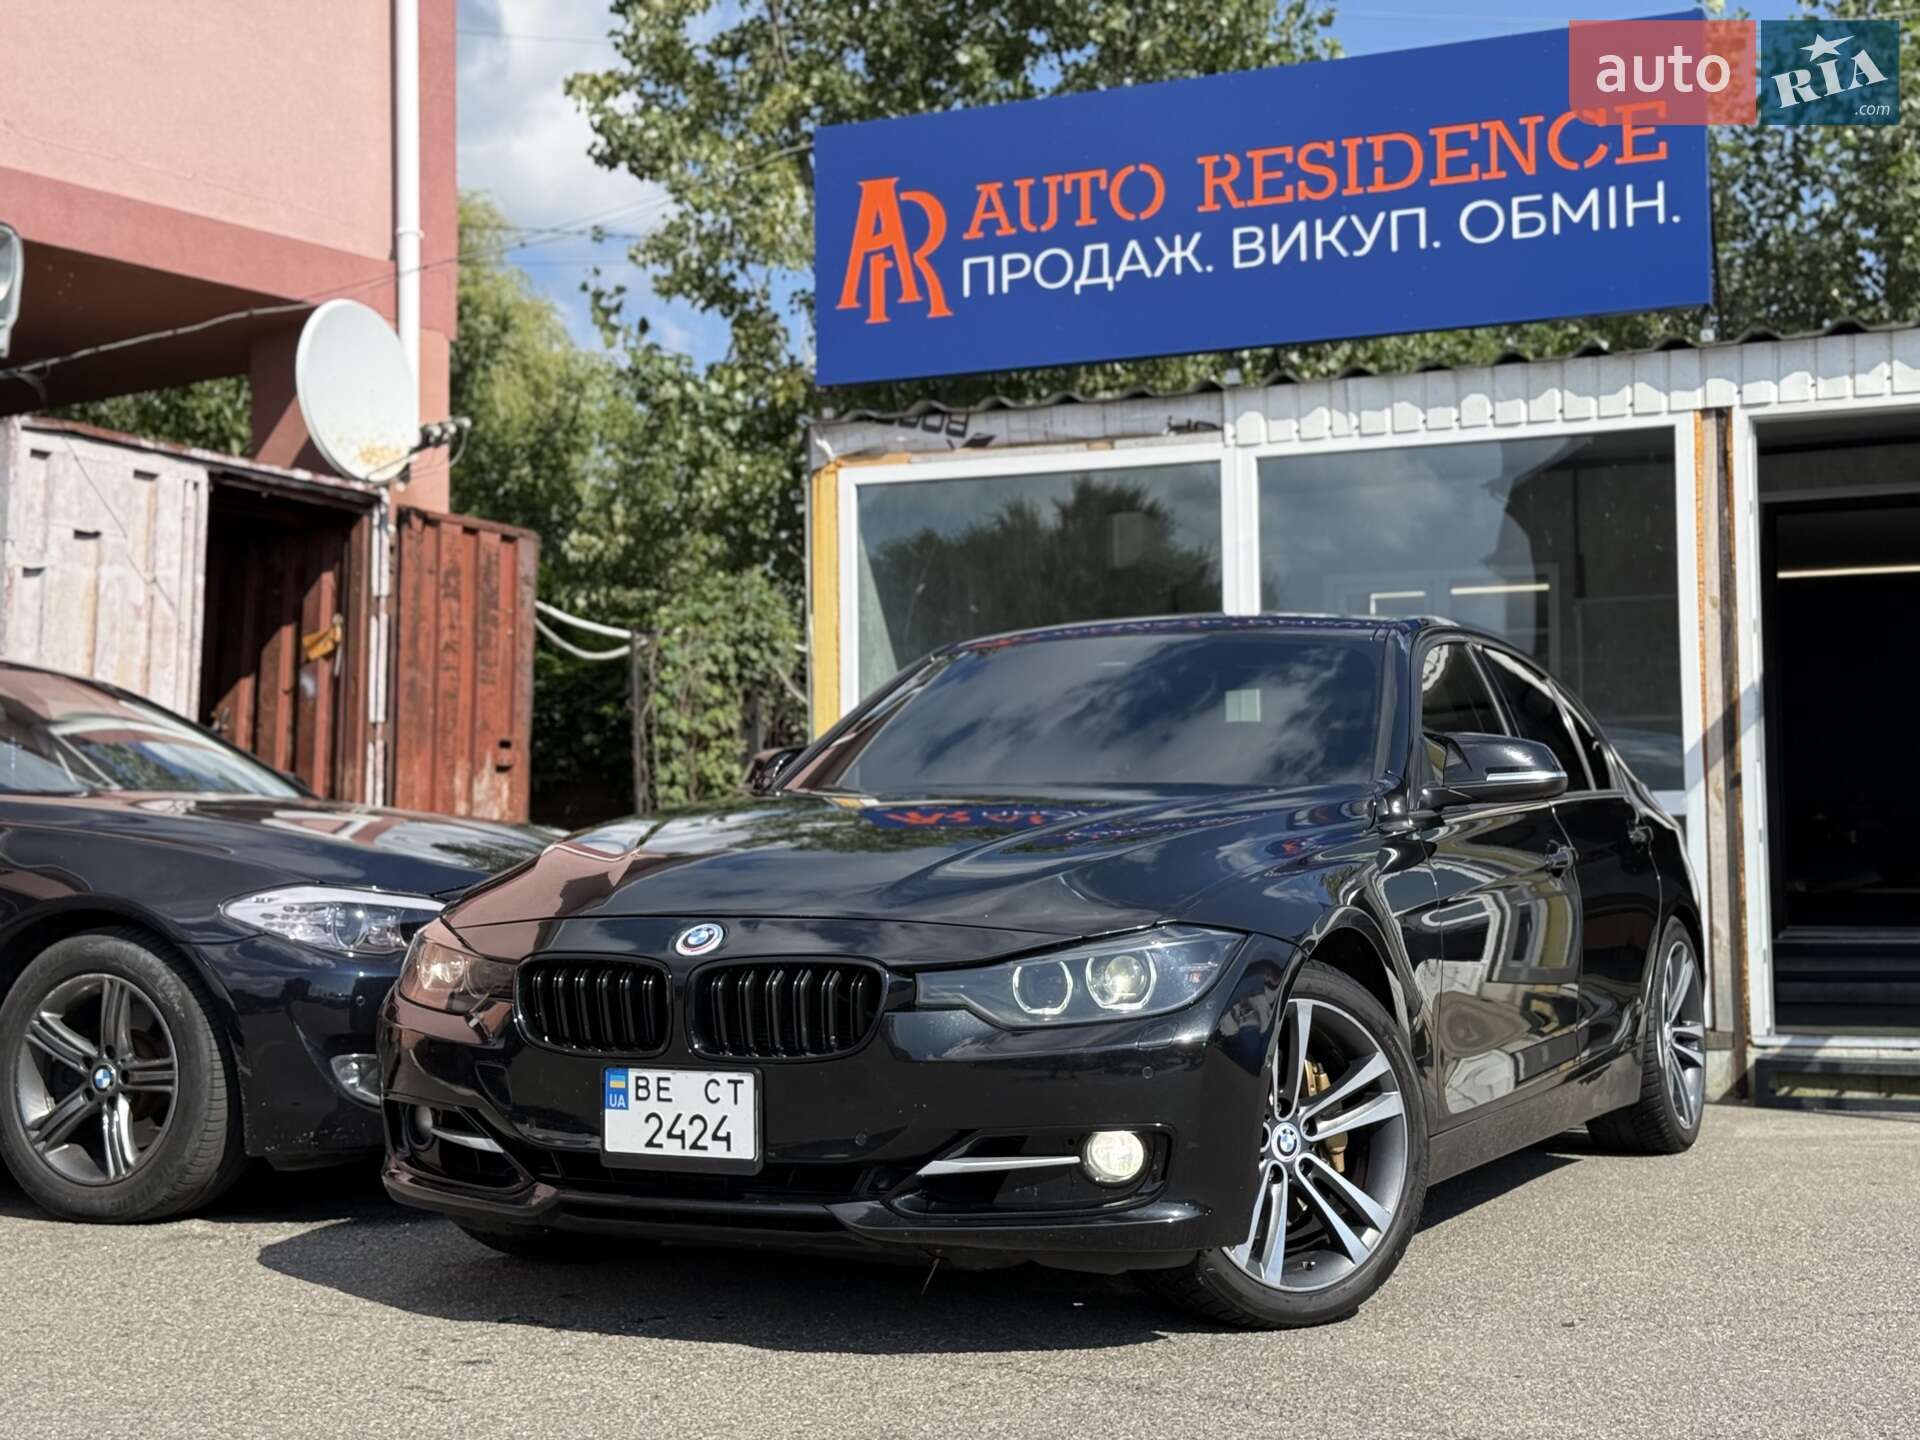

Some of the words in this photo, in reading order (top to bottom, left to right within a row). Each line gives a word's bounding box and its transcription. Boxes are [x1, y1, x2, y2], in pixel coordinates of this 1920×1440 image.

[962, 163, 1166, 240] AUTO
[1196, 100, 1668, 213] RESIDENCE
[961, 232, 1214, 297] ПРОДАЖ.
[1231, 206, 1441, 269] ВИКУП.
[1459, 180, 1681, 243] ОБМІН.
[608, 1093, 626, 1108] UA
[634, 1075, 673, 1102] BE
[704, 1078, 744, 1105] CT
[643, 1112, 732, 1152] 2424
